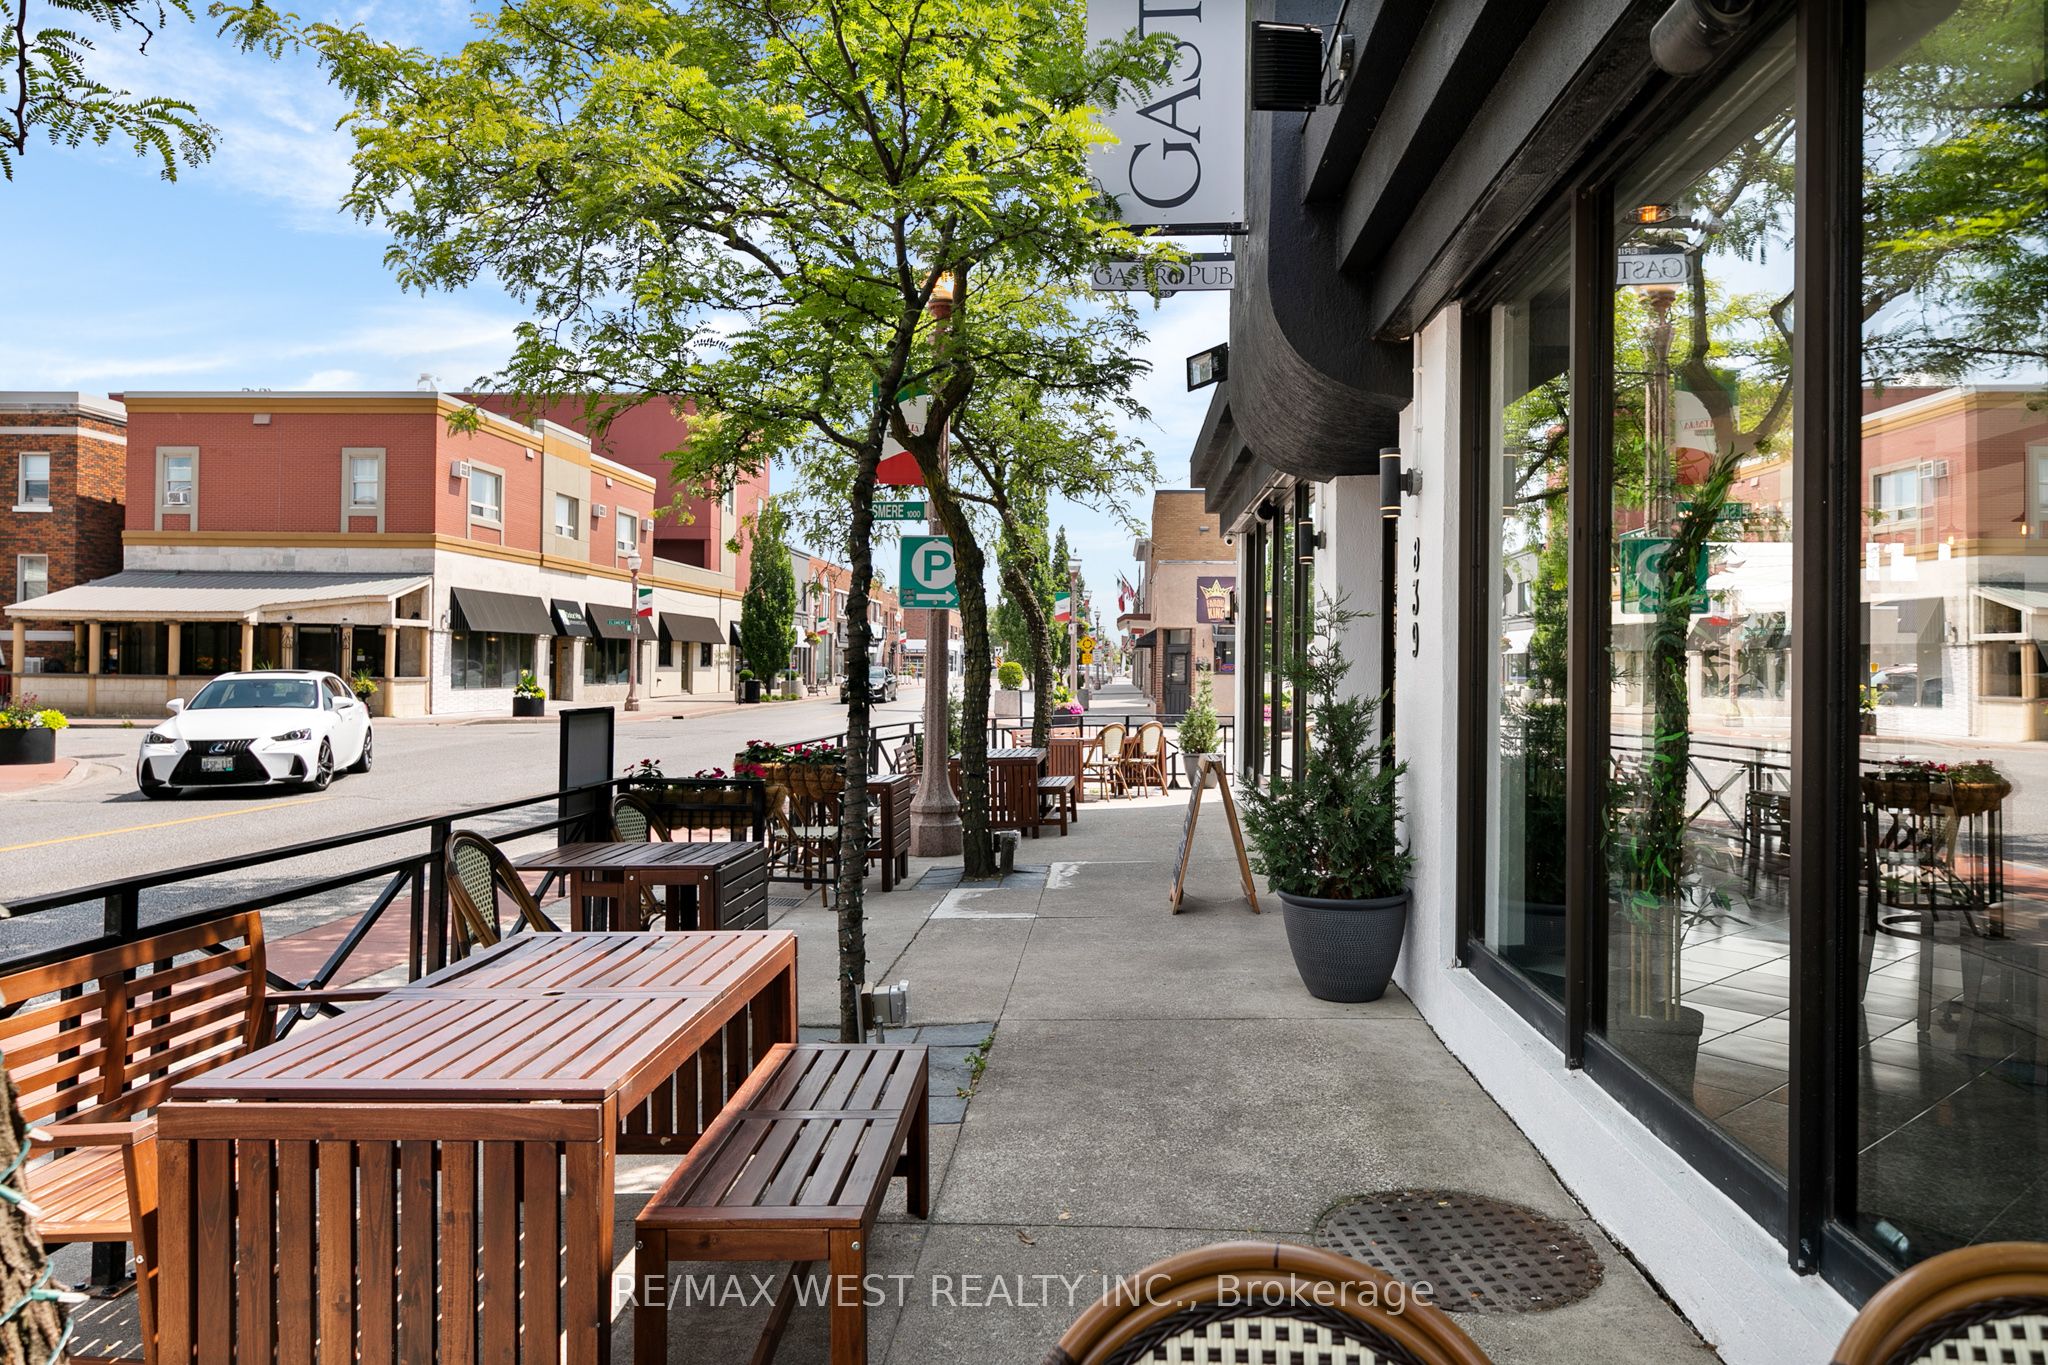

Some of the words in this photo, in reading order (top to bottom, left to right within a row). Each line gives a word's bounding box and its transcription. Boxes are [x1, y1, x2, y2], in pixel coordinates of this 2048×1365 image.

[1093, 264, 1234, 287] GASROPUB
[872, 504, 905, 518] SMERE
[923, 550, 952, 582] P
